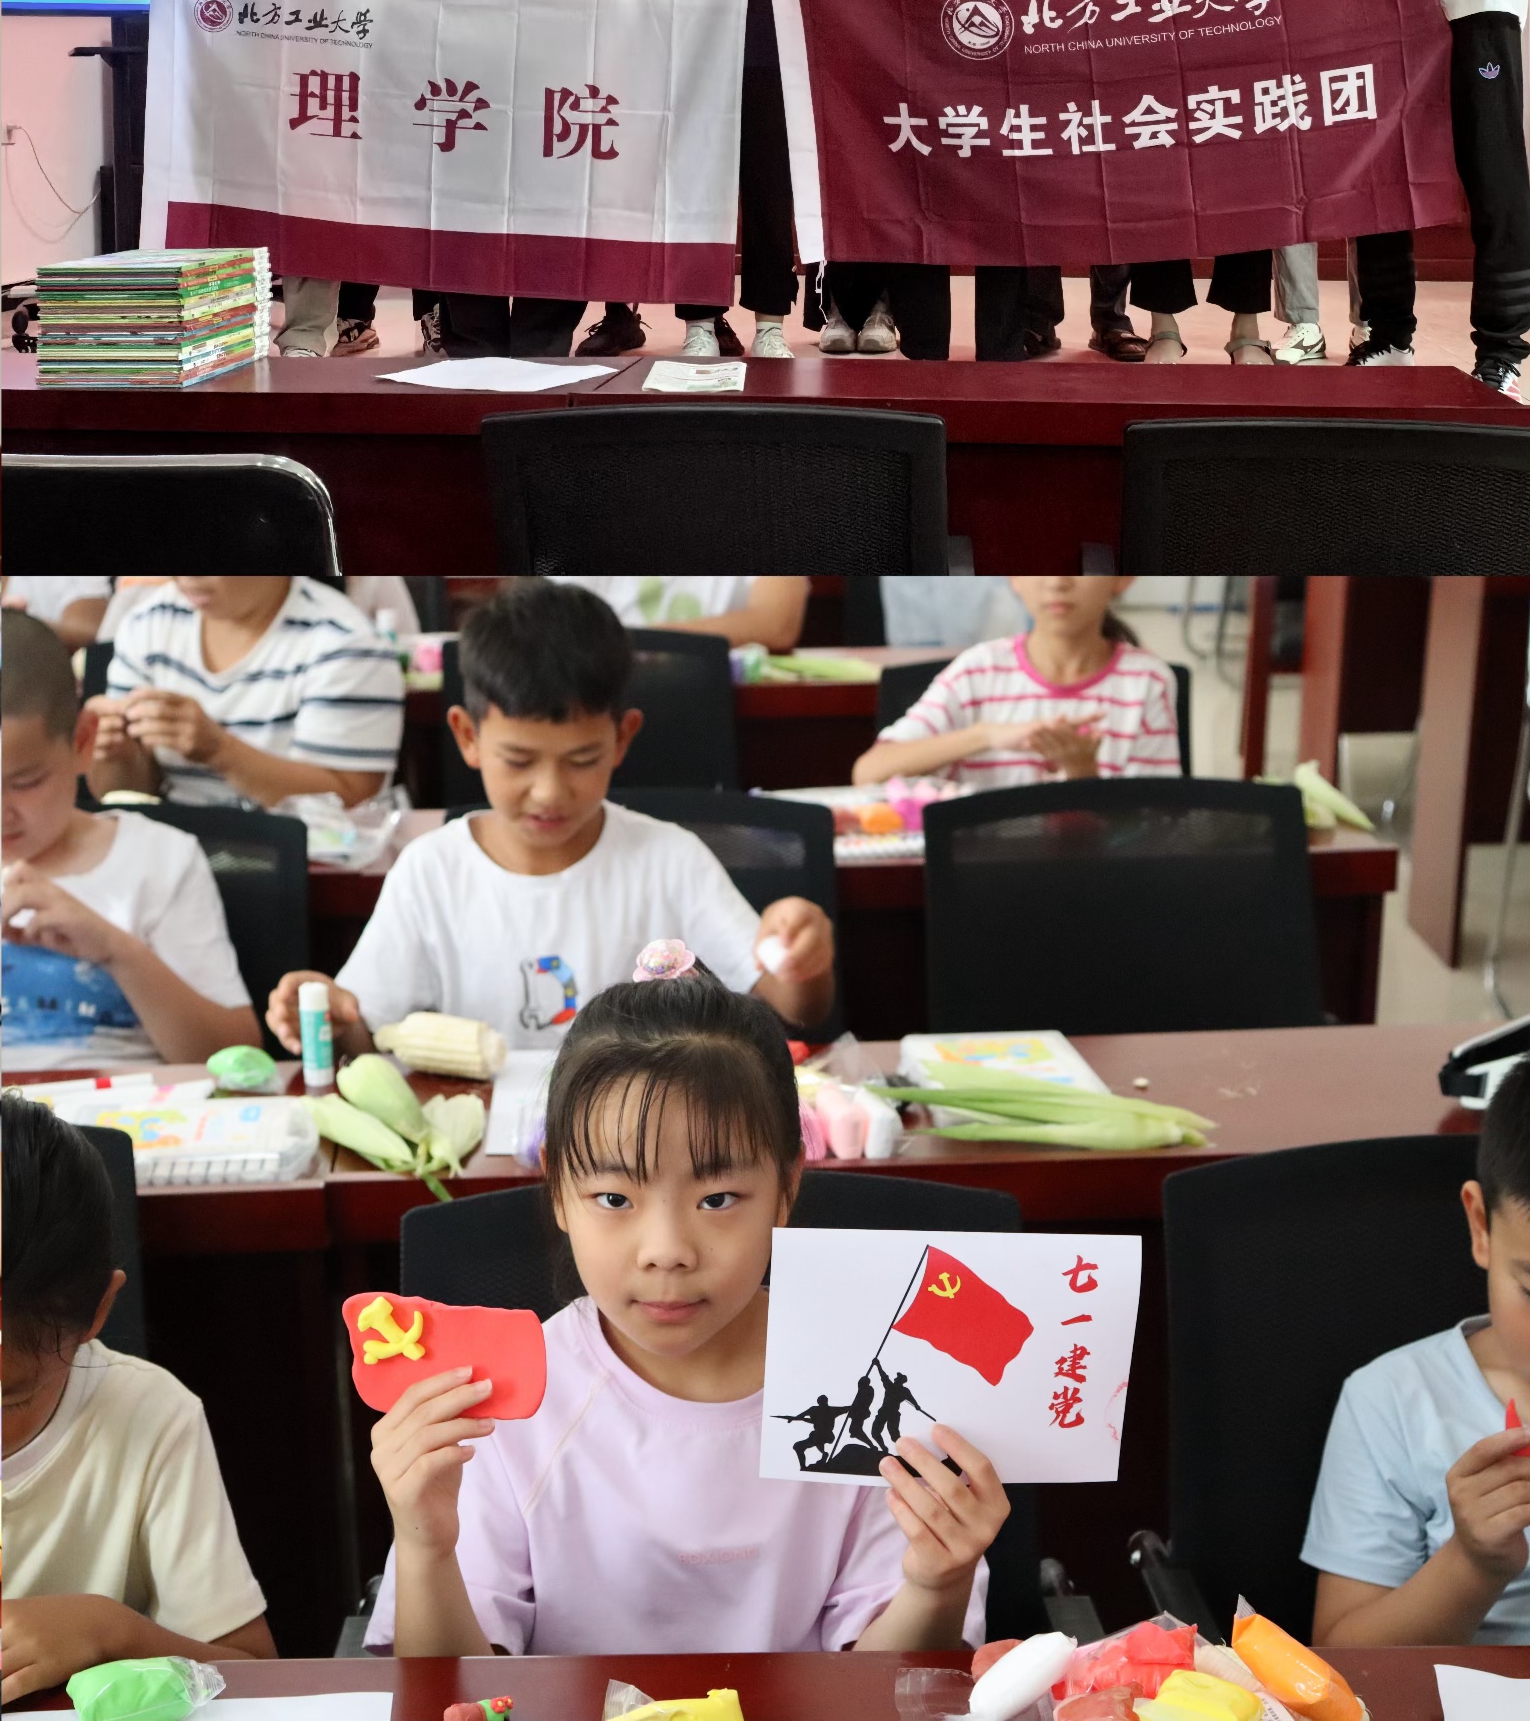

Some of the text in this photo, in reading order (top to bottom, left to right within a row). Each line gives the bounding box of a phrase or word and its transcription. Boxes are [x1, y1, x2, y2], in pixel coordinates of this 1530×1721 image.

[237, 30, 259, 38] NORTH
[238, 1, 374, 40] 北方工业大学
[1024, 15, 1283, 55] NORTH CHINA UNIVERSITY OF TECHNOLOGY
[289, 69, 621, 161] 理学院
[883, 62, 1379, 157] 大学生社会实践团
[1048, 1254, 1100, 1430] 七一建党
